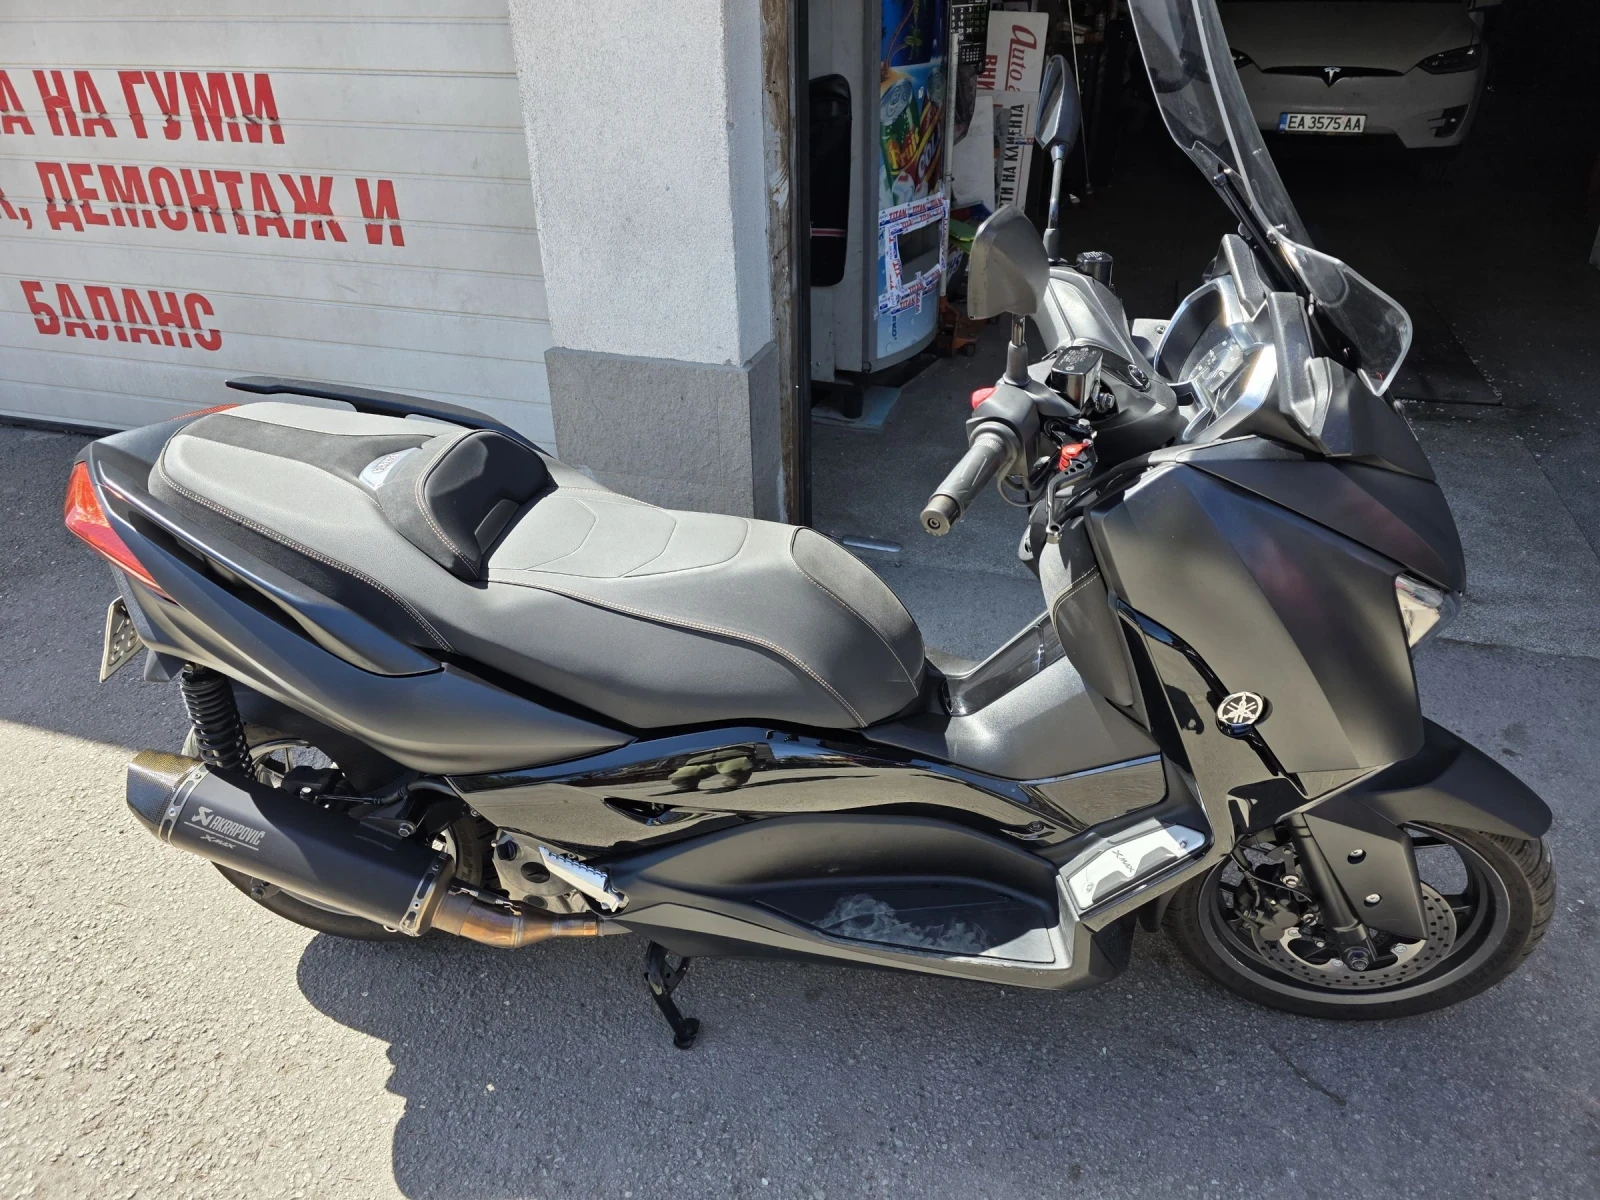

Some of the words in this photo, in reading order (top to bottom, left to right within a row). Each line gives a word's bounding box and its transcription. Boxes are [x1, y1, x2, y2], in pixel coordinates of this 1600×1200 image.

[32, 70, 117, 138] НА
[117, 71, 285, 145] ГУМИ
[1288, 115, 1305, 129] EA
[1308, 116, 1342, 130] 3575
[1343, 117, 1361, 131] AA
[35, 161, 348, 243] ДЕМОНТАЖ
[355, 178, 406, 248] И
[1002, 166, 1017, 183] НА
[19, 280, 223, 352] БАЛАНС
